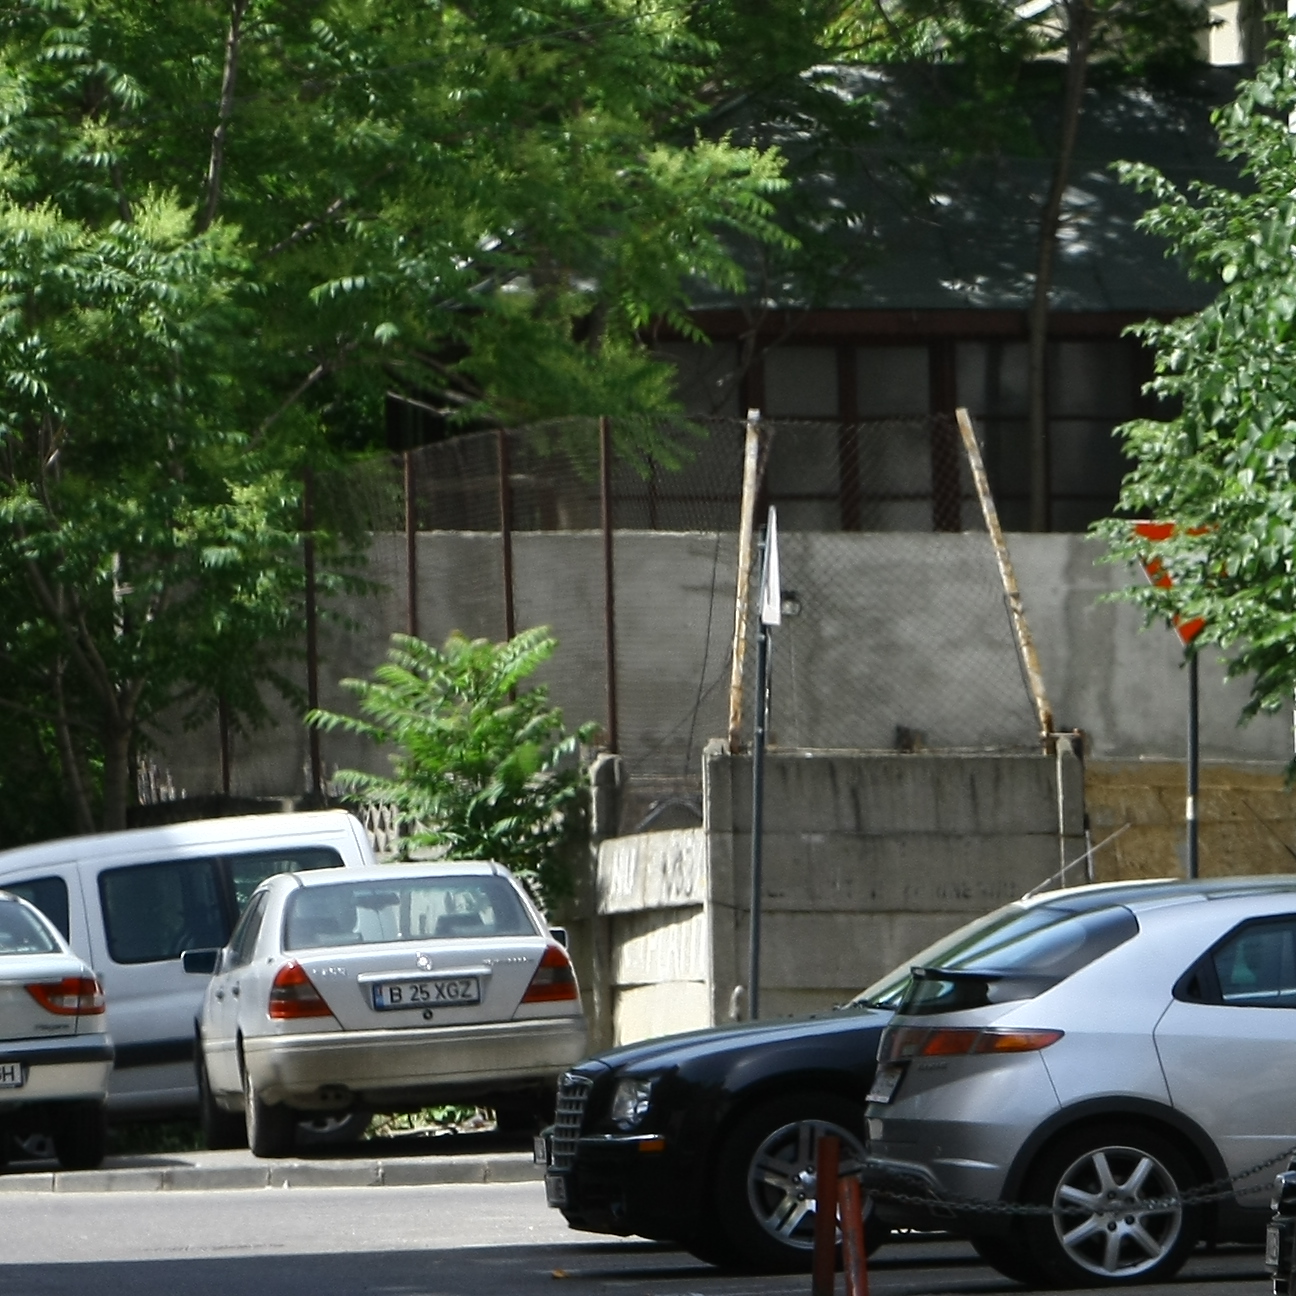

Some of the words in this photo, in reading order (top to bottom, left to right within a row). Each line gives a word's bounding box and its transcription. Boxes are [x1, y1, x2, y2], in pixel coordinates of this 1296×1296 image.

[389, 986, 402, 1003] B
[410, 984, 431, 1001] 25
[434, 980, 472, 999] XGZ
[0, 1065, 15, 1082] H
